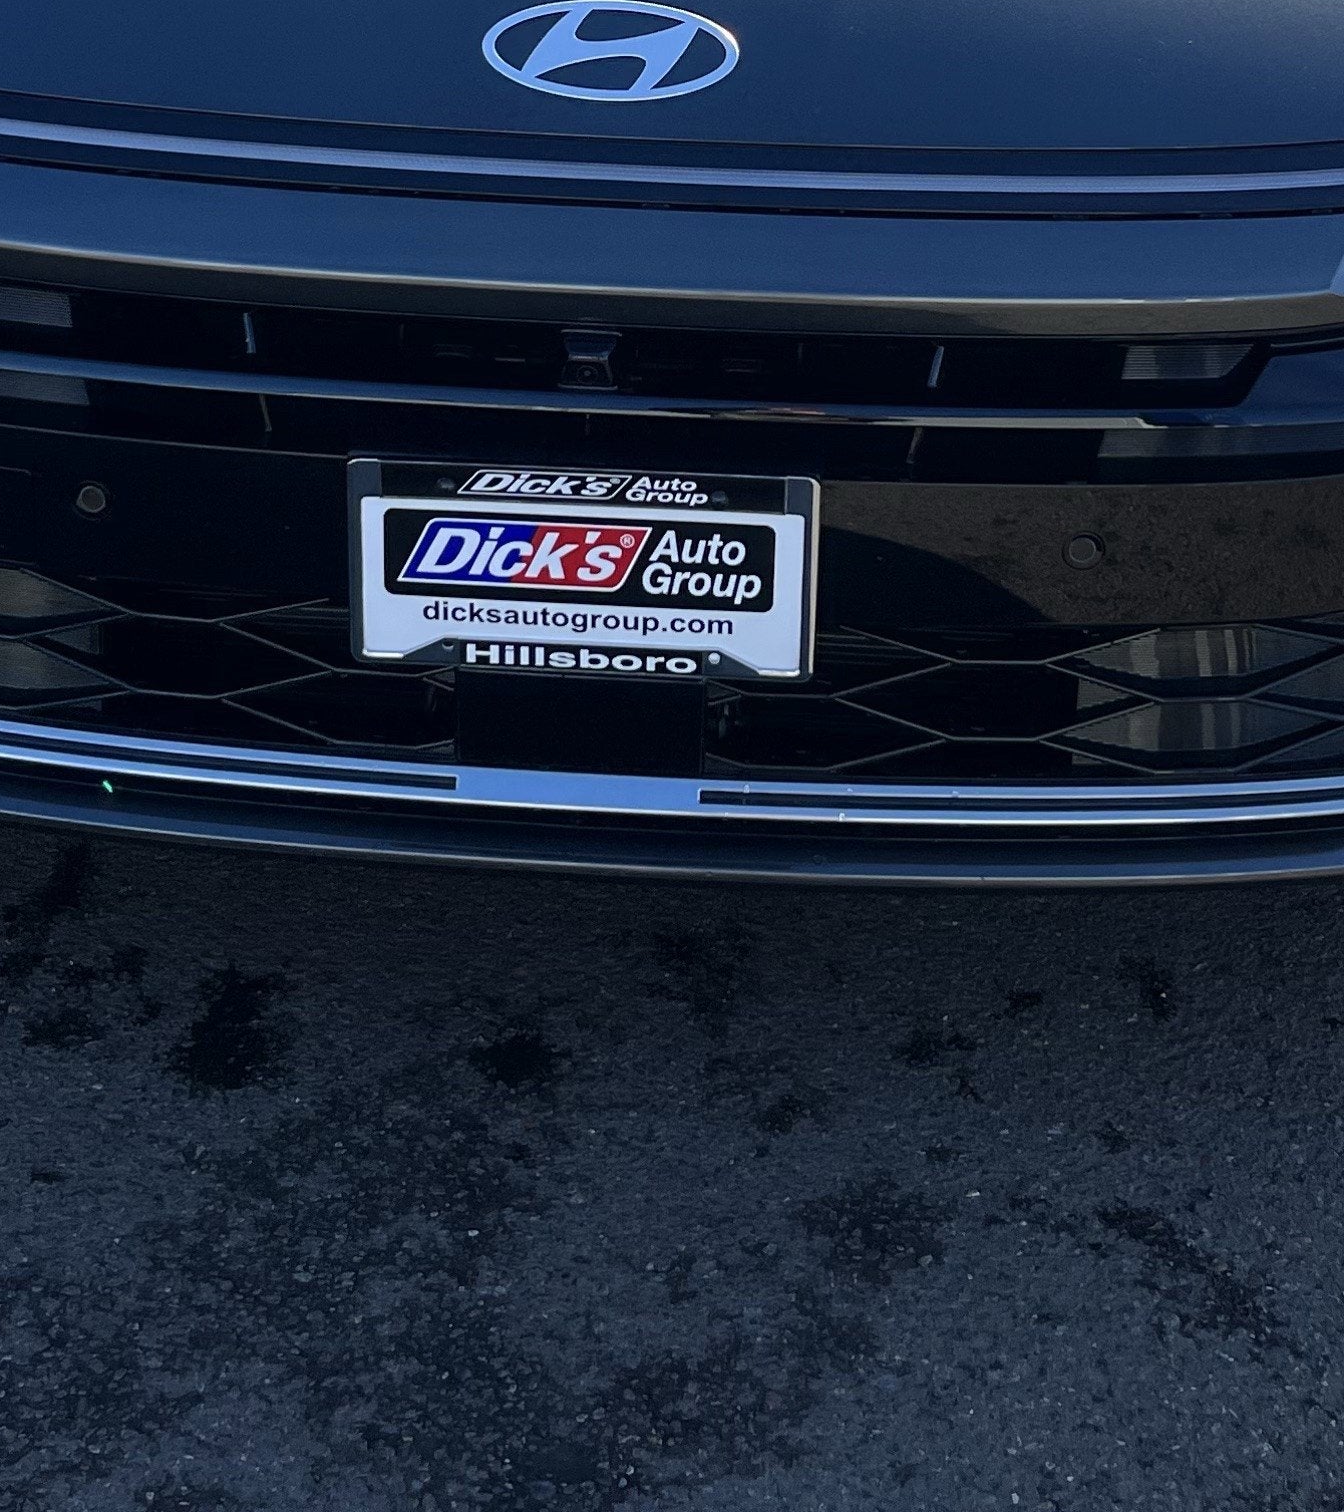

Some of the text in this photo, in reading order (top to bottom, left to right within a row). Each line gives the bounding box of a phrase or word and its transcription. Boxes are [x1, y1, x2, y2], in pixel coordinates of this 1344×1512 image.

[625, 489, 709, 506] Group
[631, 476, 697, 492] Auto
[649, 530, 747, 566] Auto
[642, 563, 762, 605] Group
[423, 600, 734, 636] dicksautogroup.com
[465, 643, 698, 674] Hillsboro
